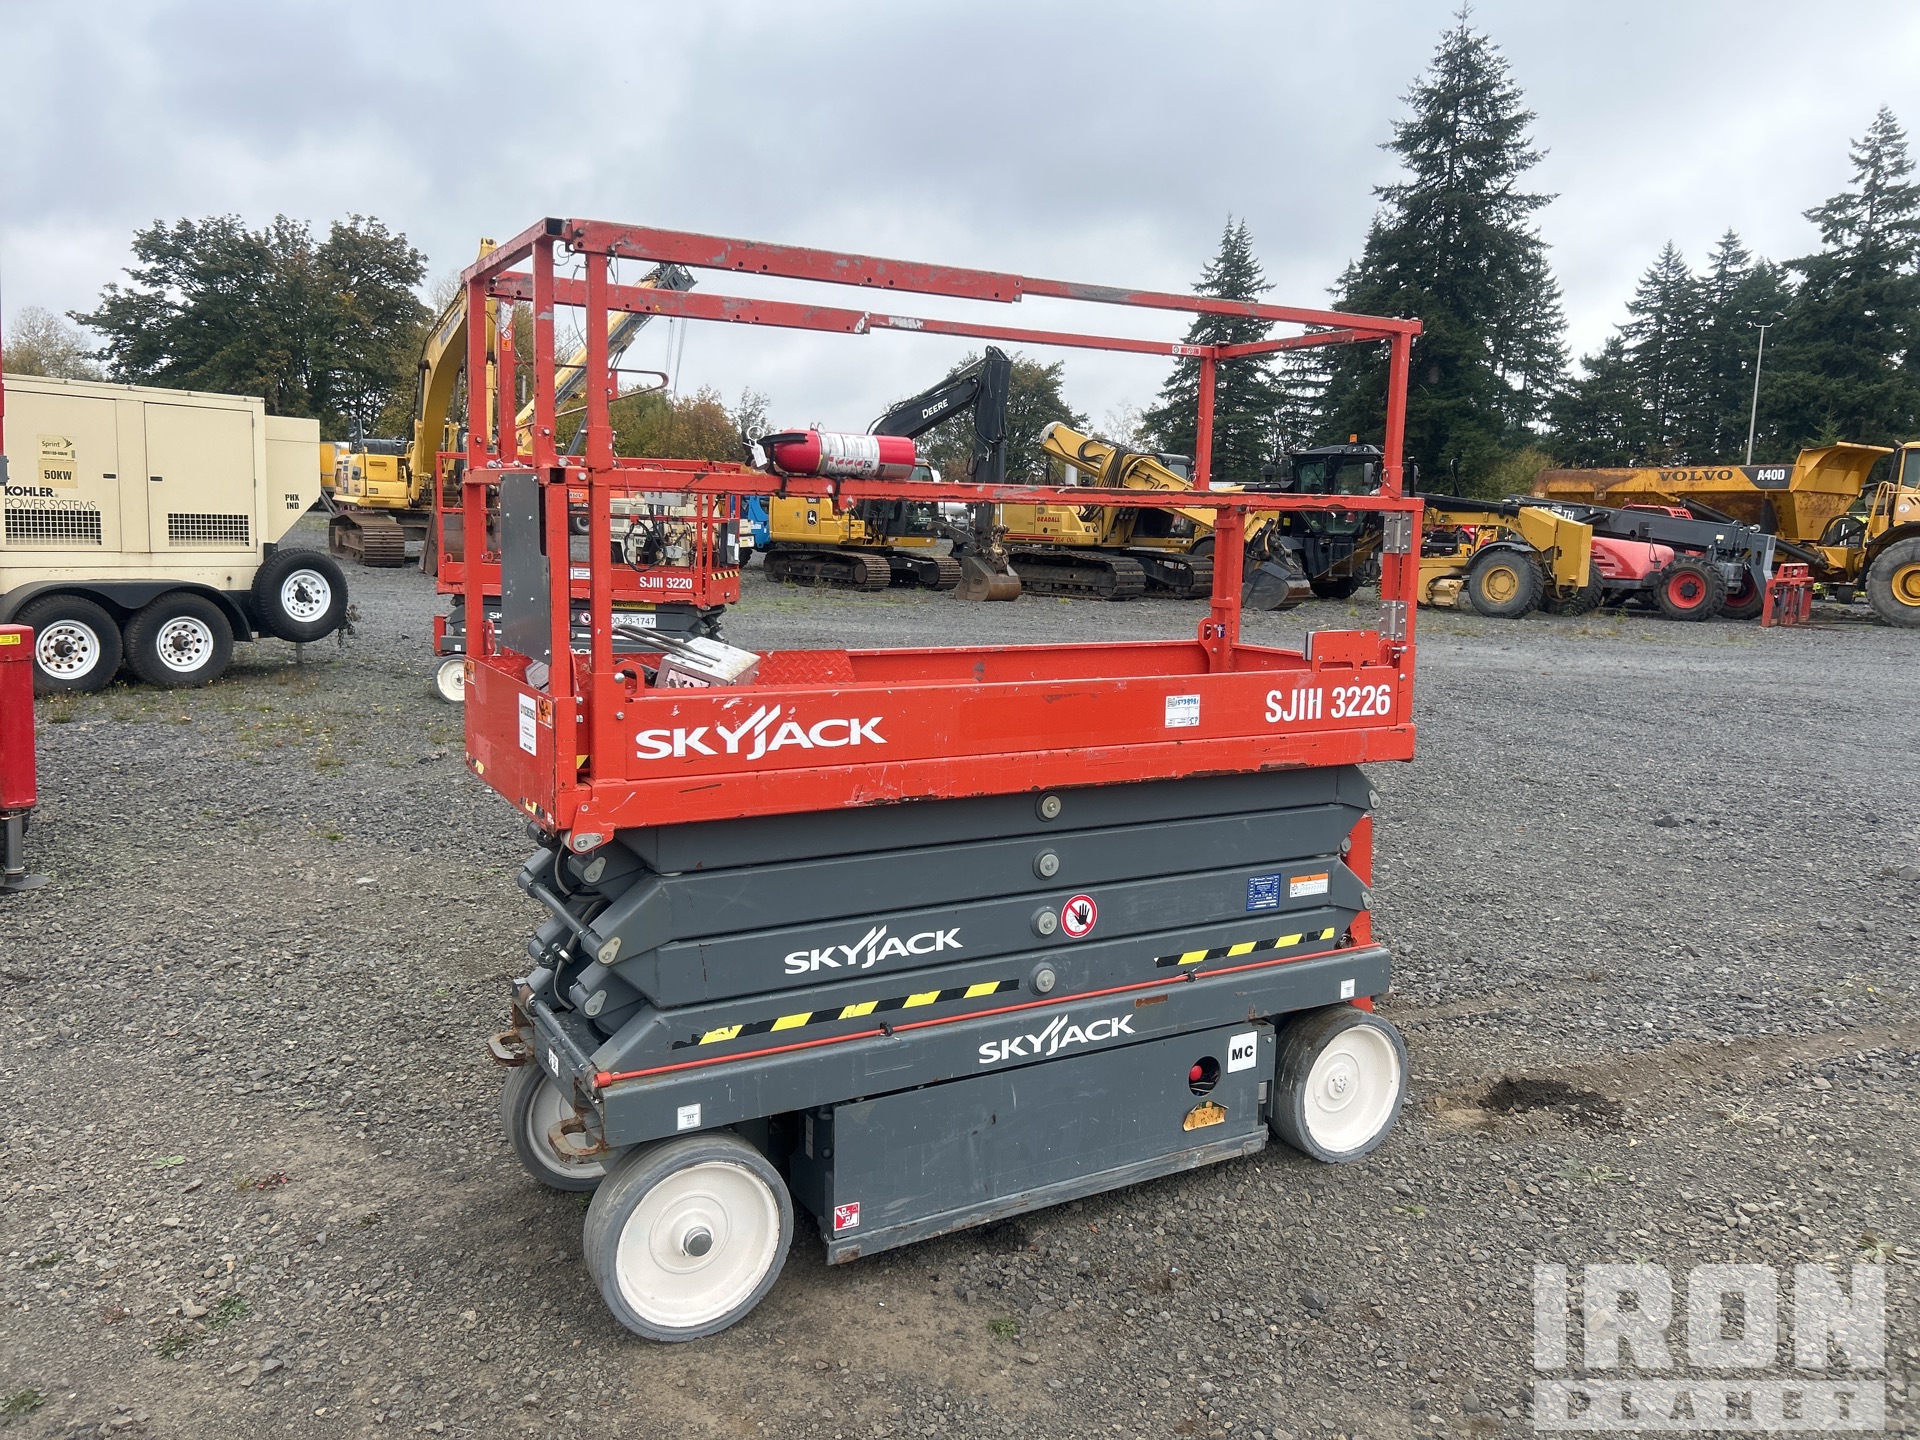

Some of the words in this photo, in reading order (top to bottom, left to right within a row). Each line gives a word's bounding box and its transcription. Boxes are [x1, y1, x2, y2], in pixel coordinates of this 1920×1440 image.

[922, 398, 949, 419] DEERE
[41, 440, 60, 448] Sprint
[44, 470, 72, 480] 50KW
[1657, 470, 1733, 481] VOLVO
[1757, 469, 1785, 480] A40D
[5, 486, 54, 497] KOHLER
[284, 493, 299, 501] PHX
[5, 498, 46, 509] POWER
[49, 499, 96, 510] SYSTEMS
[639, 577, 663, 589] SJIII
[666, 577, 693, 589] 3220
[1330, 684, 1391, 718] 3226
[635, 704, 888, 761] SKYJACK
[784, 925, 964, 975] SKYJACK
[978, 1014, 1136, 1064] SKYJACK
[1232, 1045, 1254, 1061] MC
